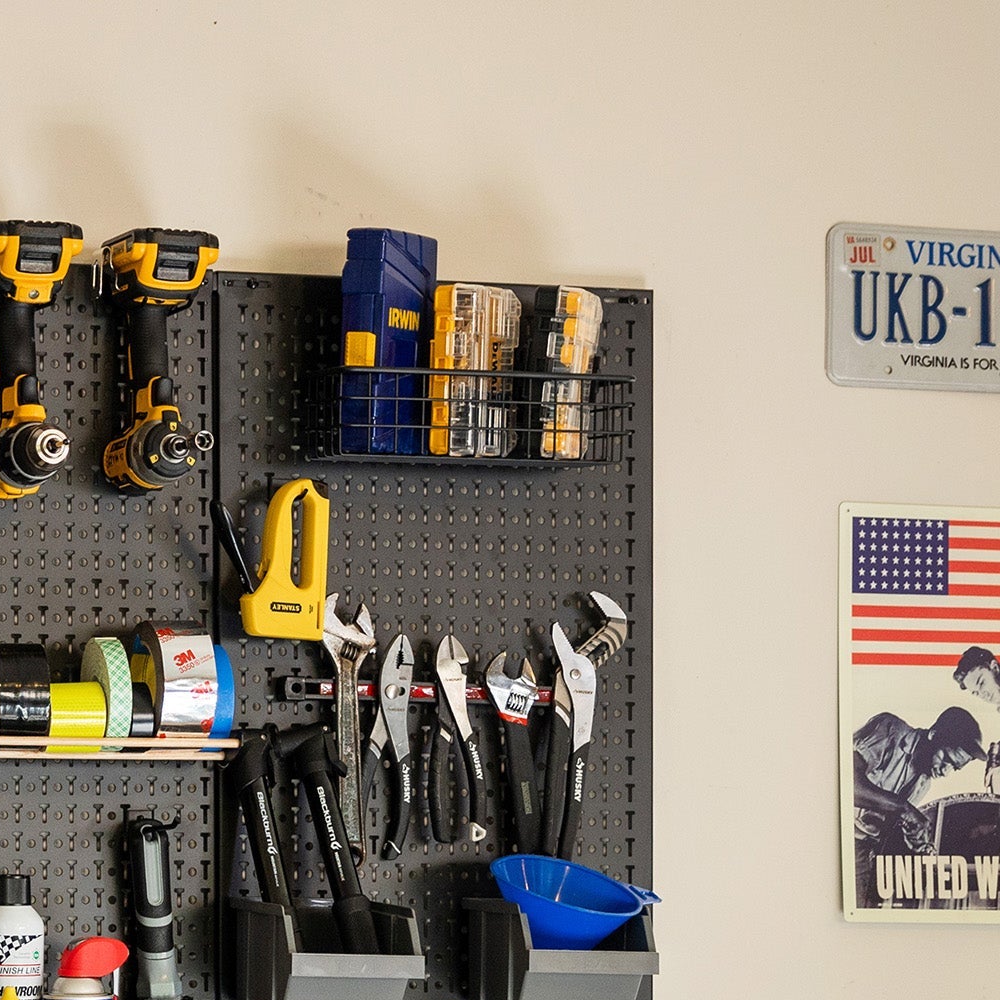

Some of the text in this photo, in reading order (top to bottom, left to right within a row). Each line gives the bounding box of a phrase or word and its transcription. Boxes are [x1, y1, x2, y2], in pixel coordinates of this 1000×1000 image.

[850, 246, 876, 263] JUL
[388, 307, 420, 332] IRWIN
[851, 270, 996, 347] UKB-1
[900, 354, 998, 371] VIRGINIA IS FOR
[272, 603, 300, 612] STANLEY
[173, 649, 196, 667] 3M
[179, 661, 195, 674] 3350
[472, 751, 484, 780] HUSKY
[574, 768, 583, 802] HUSKY
[256, 791, 274, 847] Blackburn
[316, 786, 336, 842] Blackburn
[876, 855, 968, 899] UNITED
[26, 966, 40, 974] LINE
